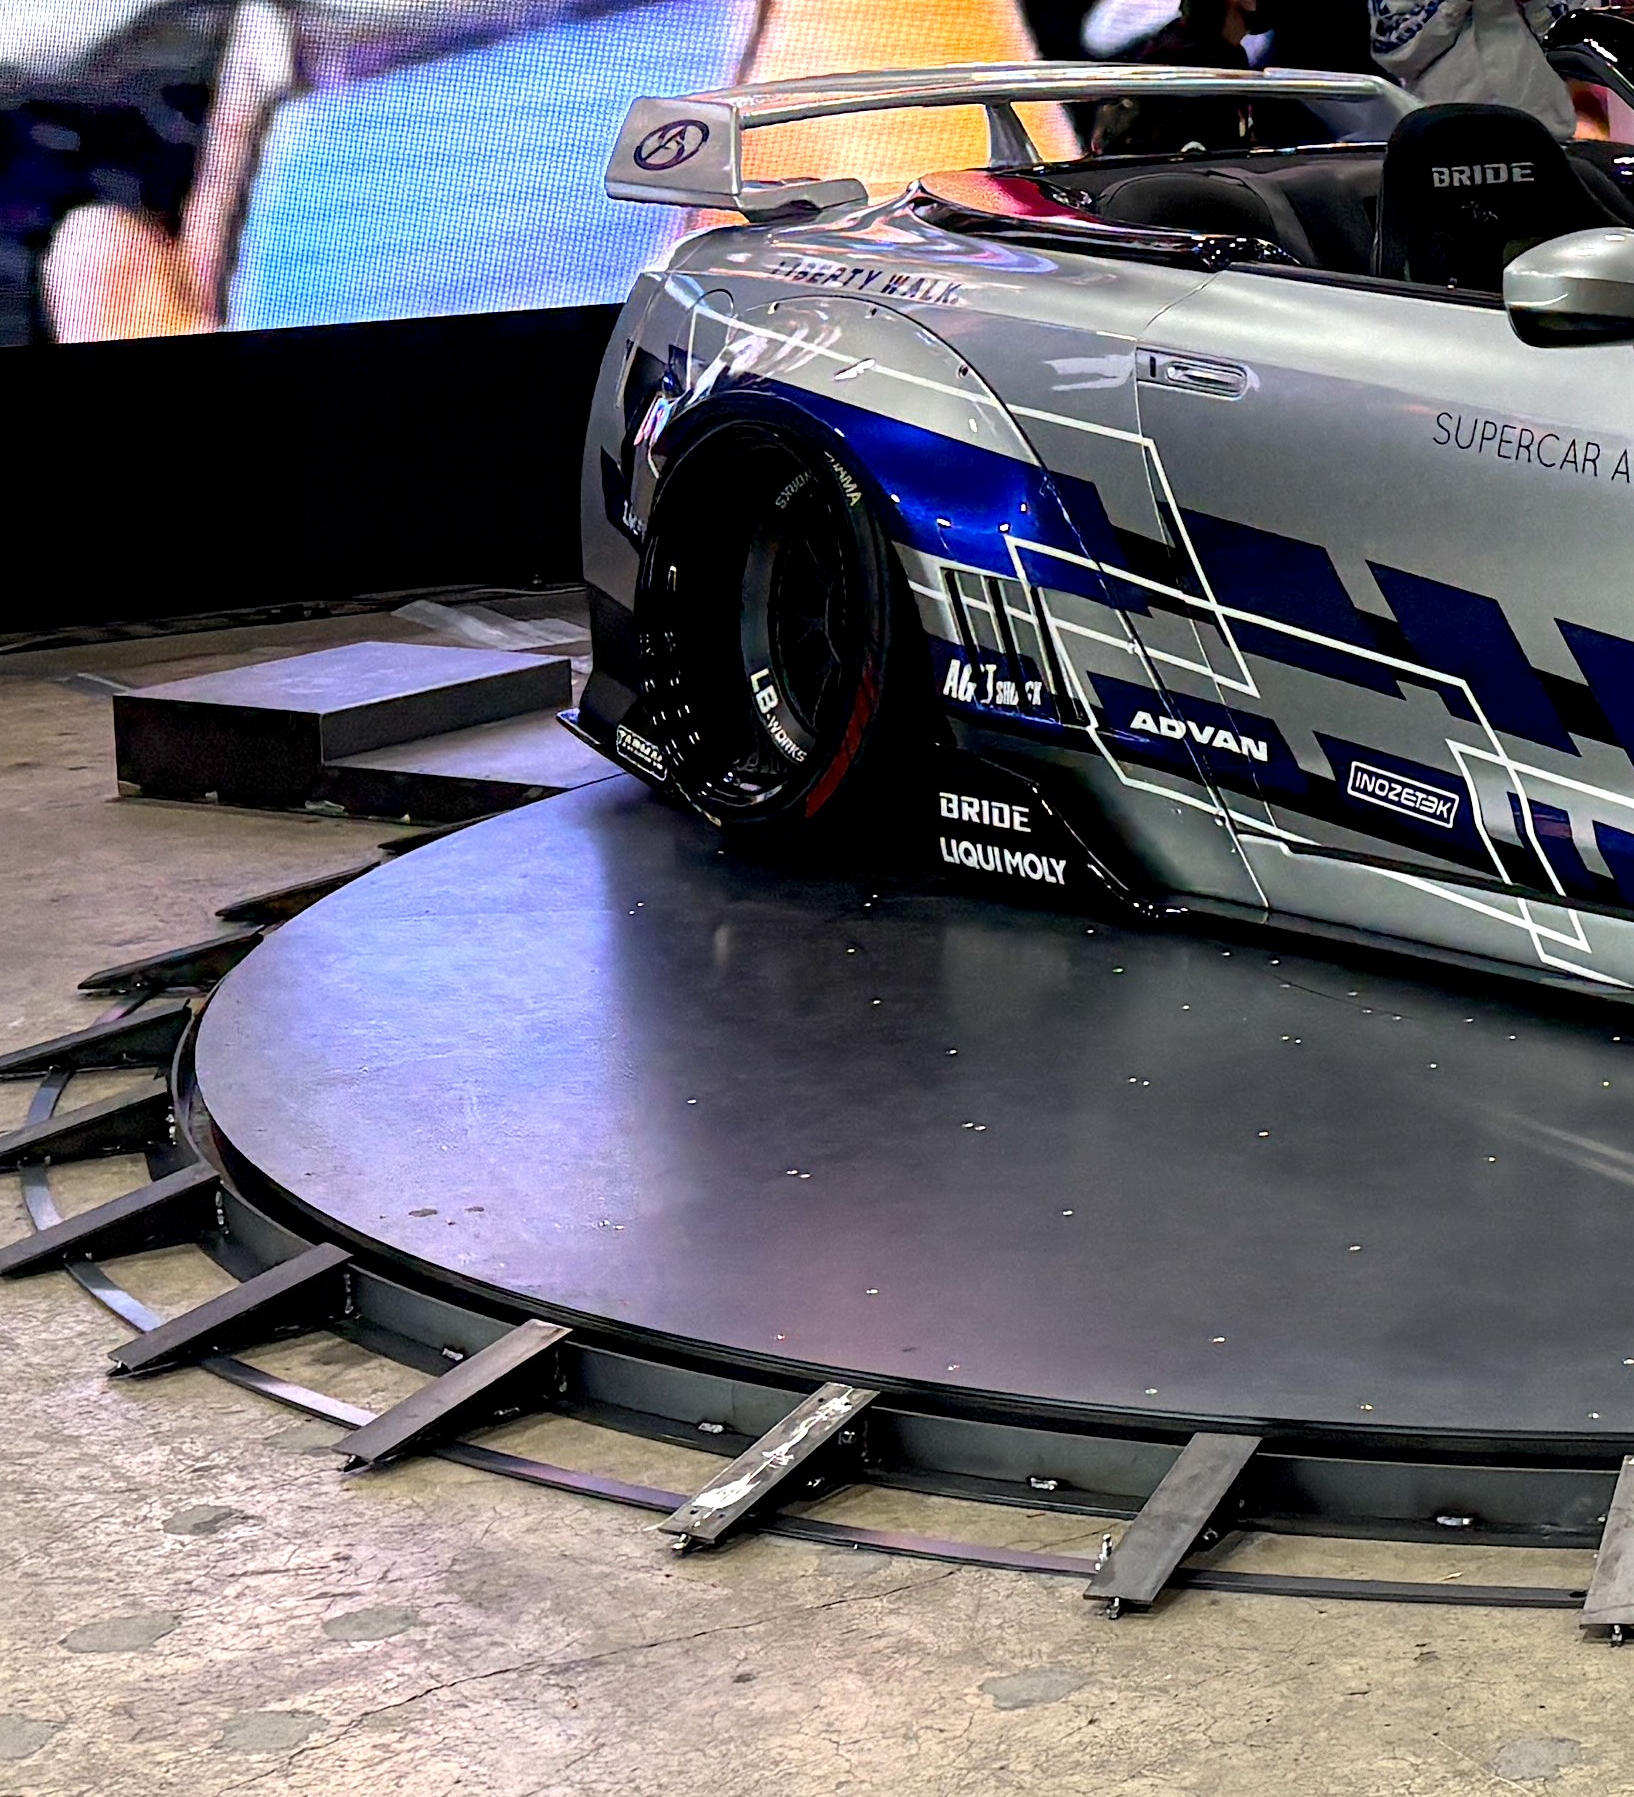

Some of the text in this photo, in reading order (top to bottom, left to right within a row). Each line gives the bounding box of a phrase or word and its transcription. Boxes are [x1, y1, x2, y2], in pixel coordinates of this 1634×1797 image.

[1431, 161, 1536, 190] BRIDE
[771, 260, 962, 304] LIBERTY WALK
[1432, 412, 1599, 478] SUPERCAR
[1129, 710, 1268, 763] ADVAN
[938, 791, 1032, 834] BRIDE
[939, 836, 1067, 886] LIQUI MOLY
